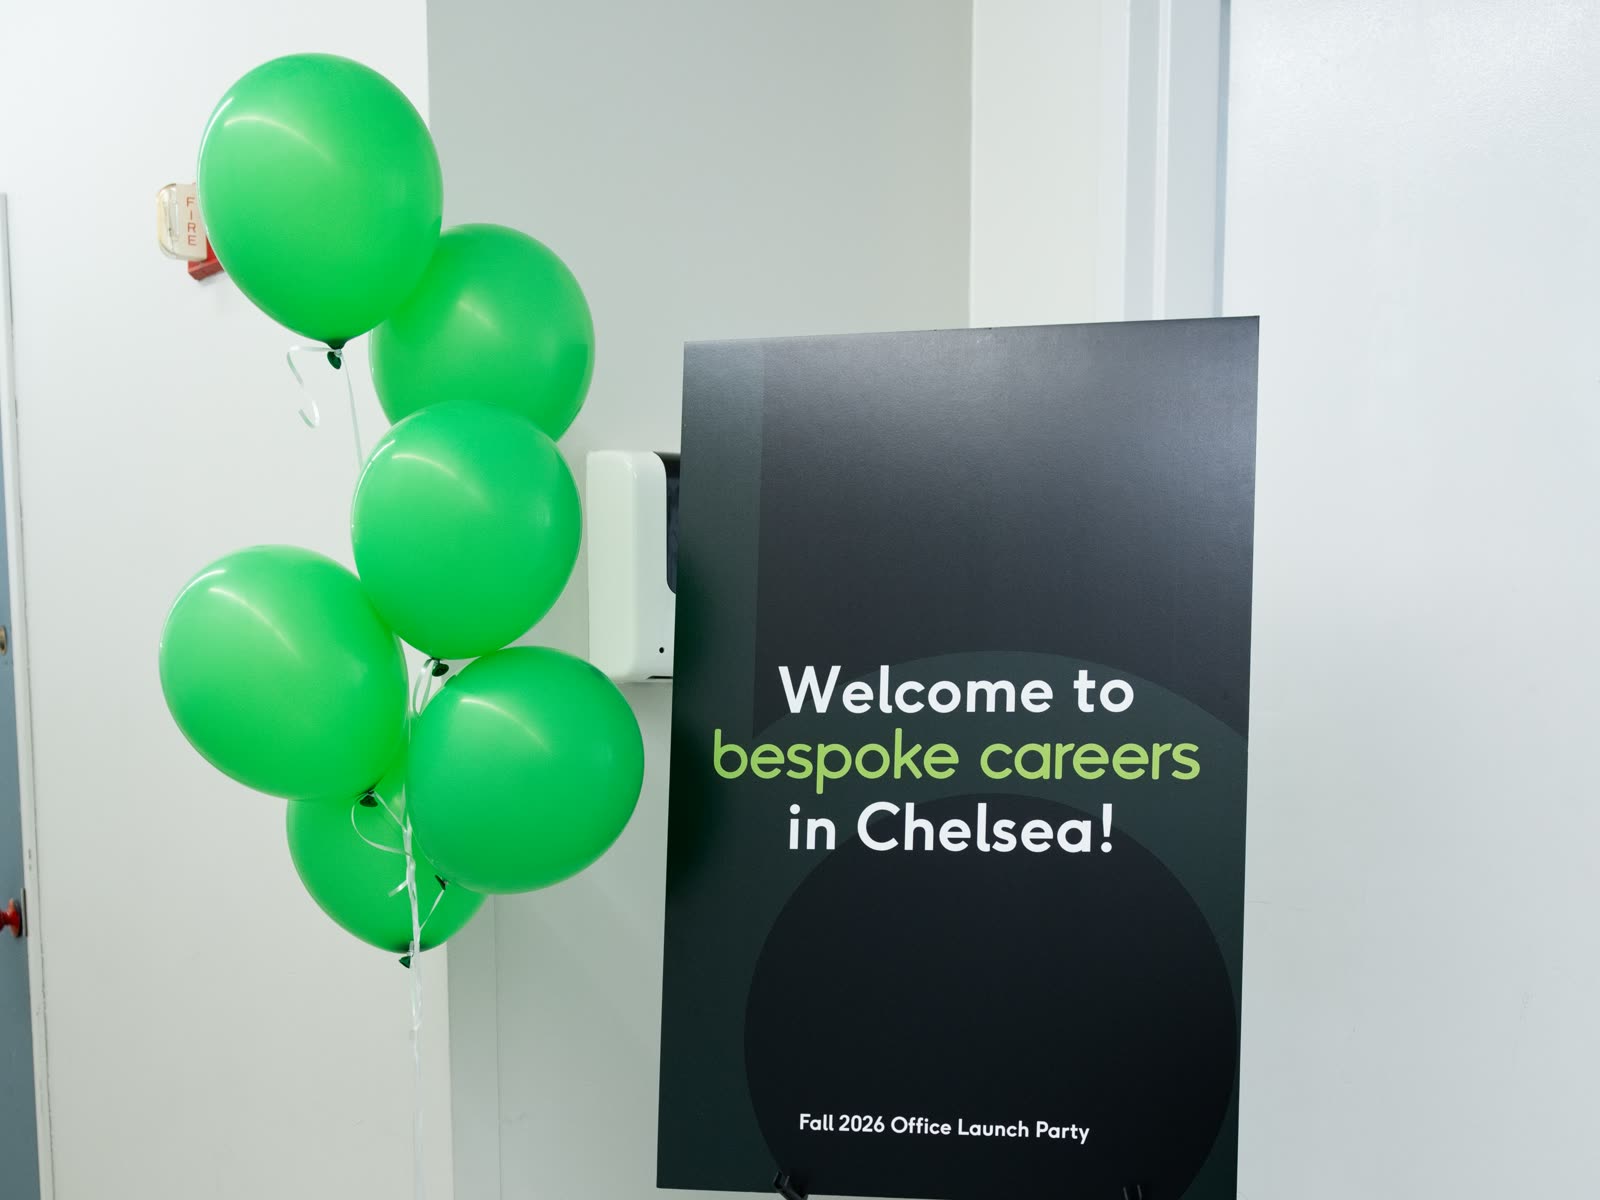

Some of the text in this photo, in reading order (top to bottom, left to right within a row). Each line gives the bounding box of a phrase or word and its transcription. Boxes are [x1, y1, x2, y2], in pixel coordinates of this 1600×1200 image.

[186, 196, 197, 246] FIRE
[778, 665, 1135, 714] Welcome to
[713, 728, 1201, 795] bespoke careers
[788, 801, 1113, 853] in Chelsea!
[799, 1113, 1090, 1145] Fall 2026 Office Launch Party
